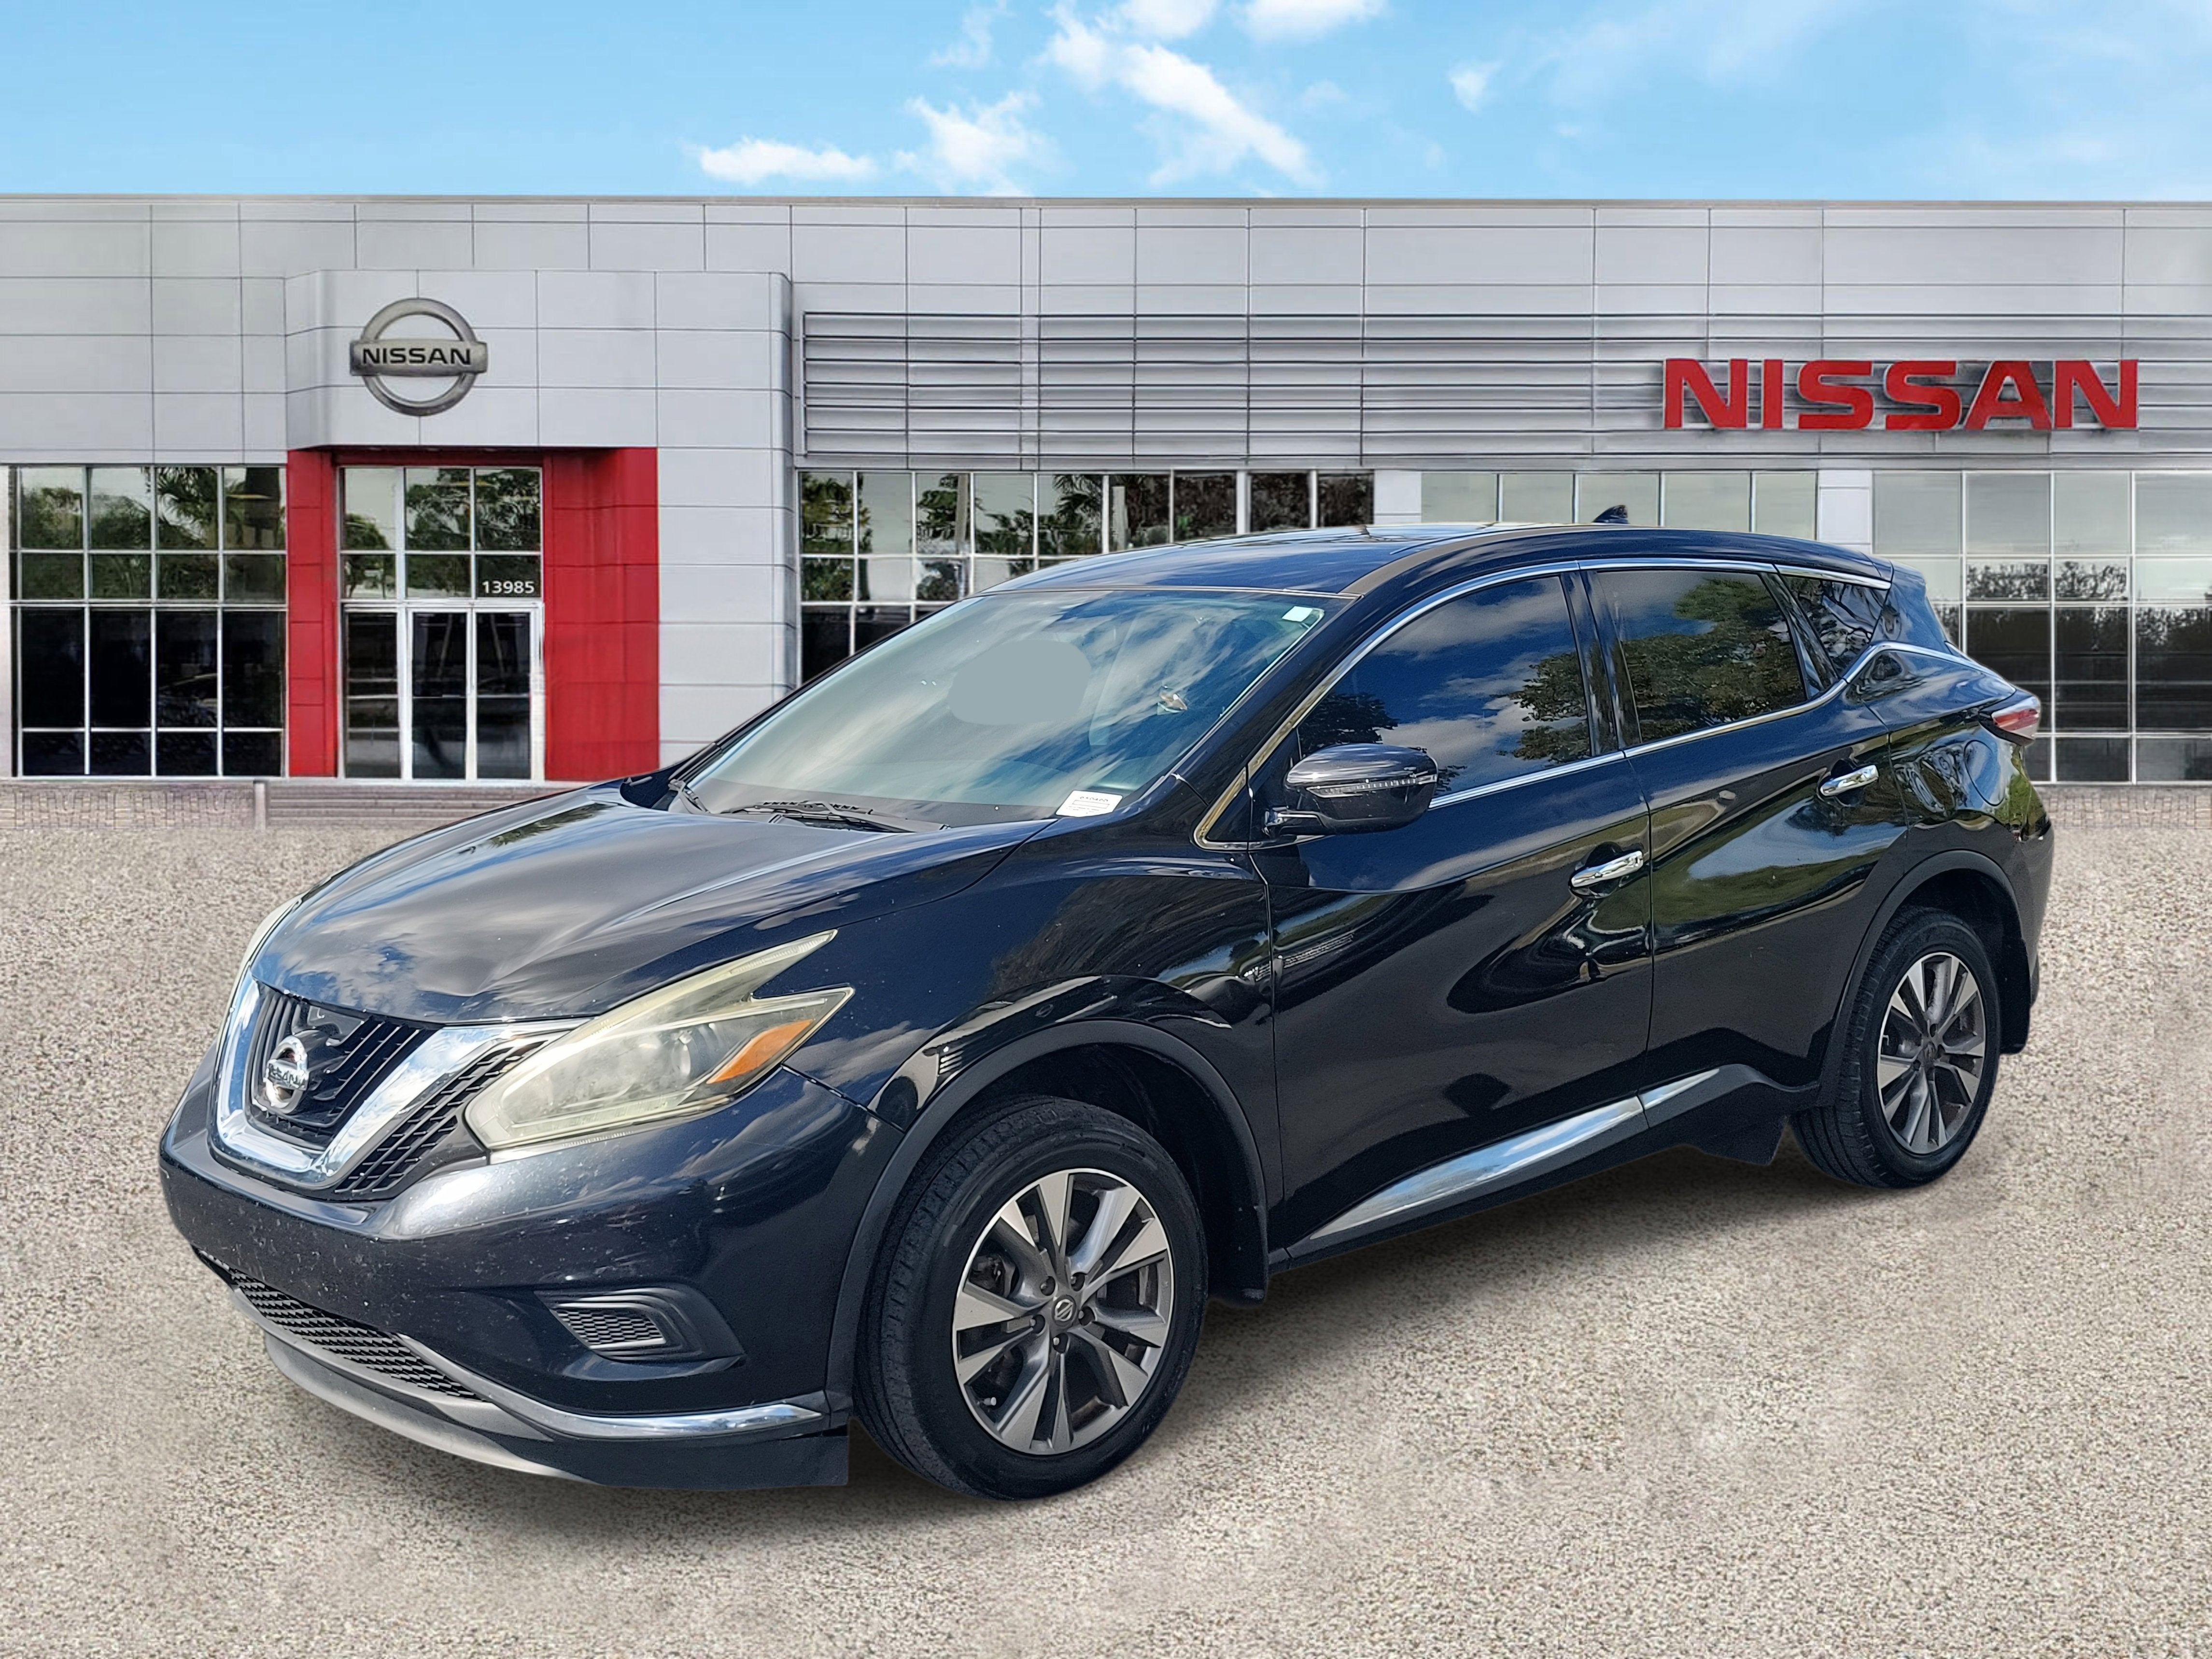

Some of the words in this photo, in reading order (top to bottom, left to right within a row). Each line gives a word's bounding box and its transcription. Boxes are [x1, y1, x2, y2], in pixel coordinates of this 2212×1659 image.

[363, 348, 470, 365] NISSAN
[1664, 358, 2139, 431] NISSAN
[482, 580, 535, 594] 13985
